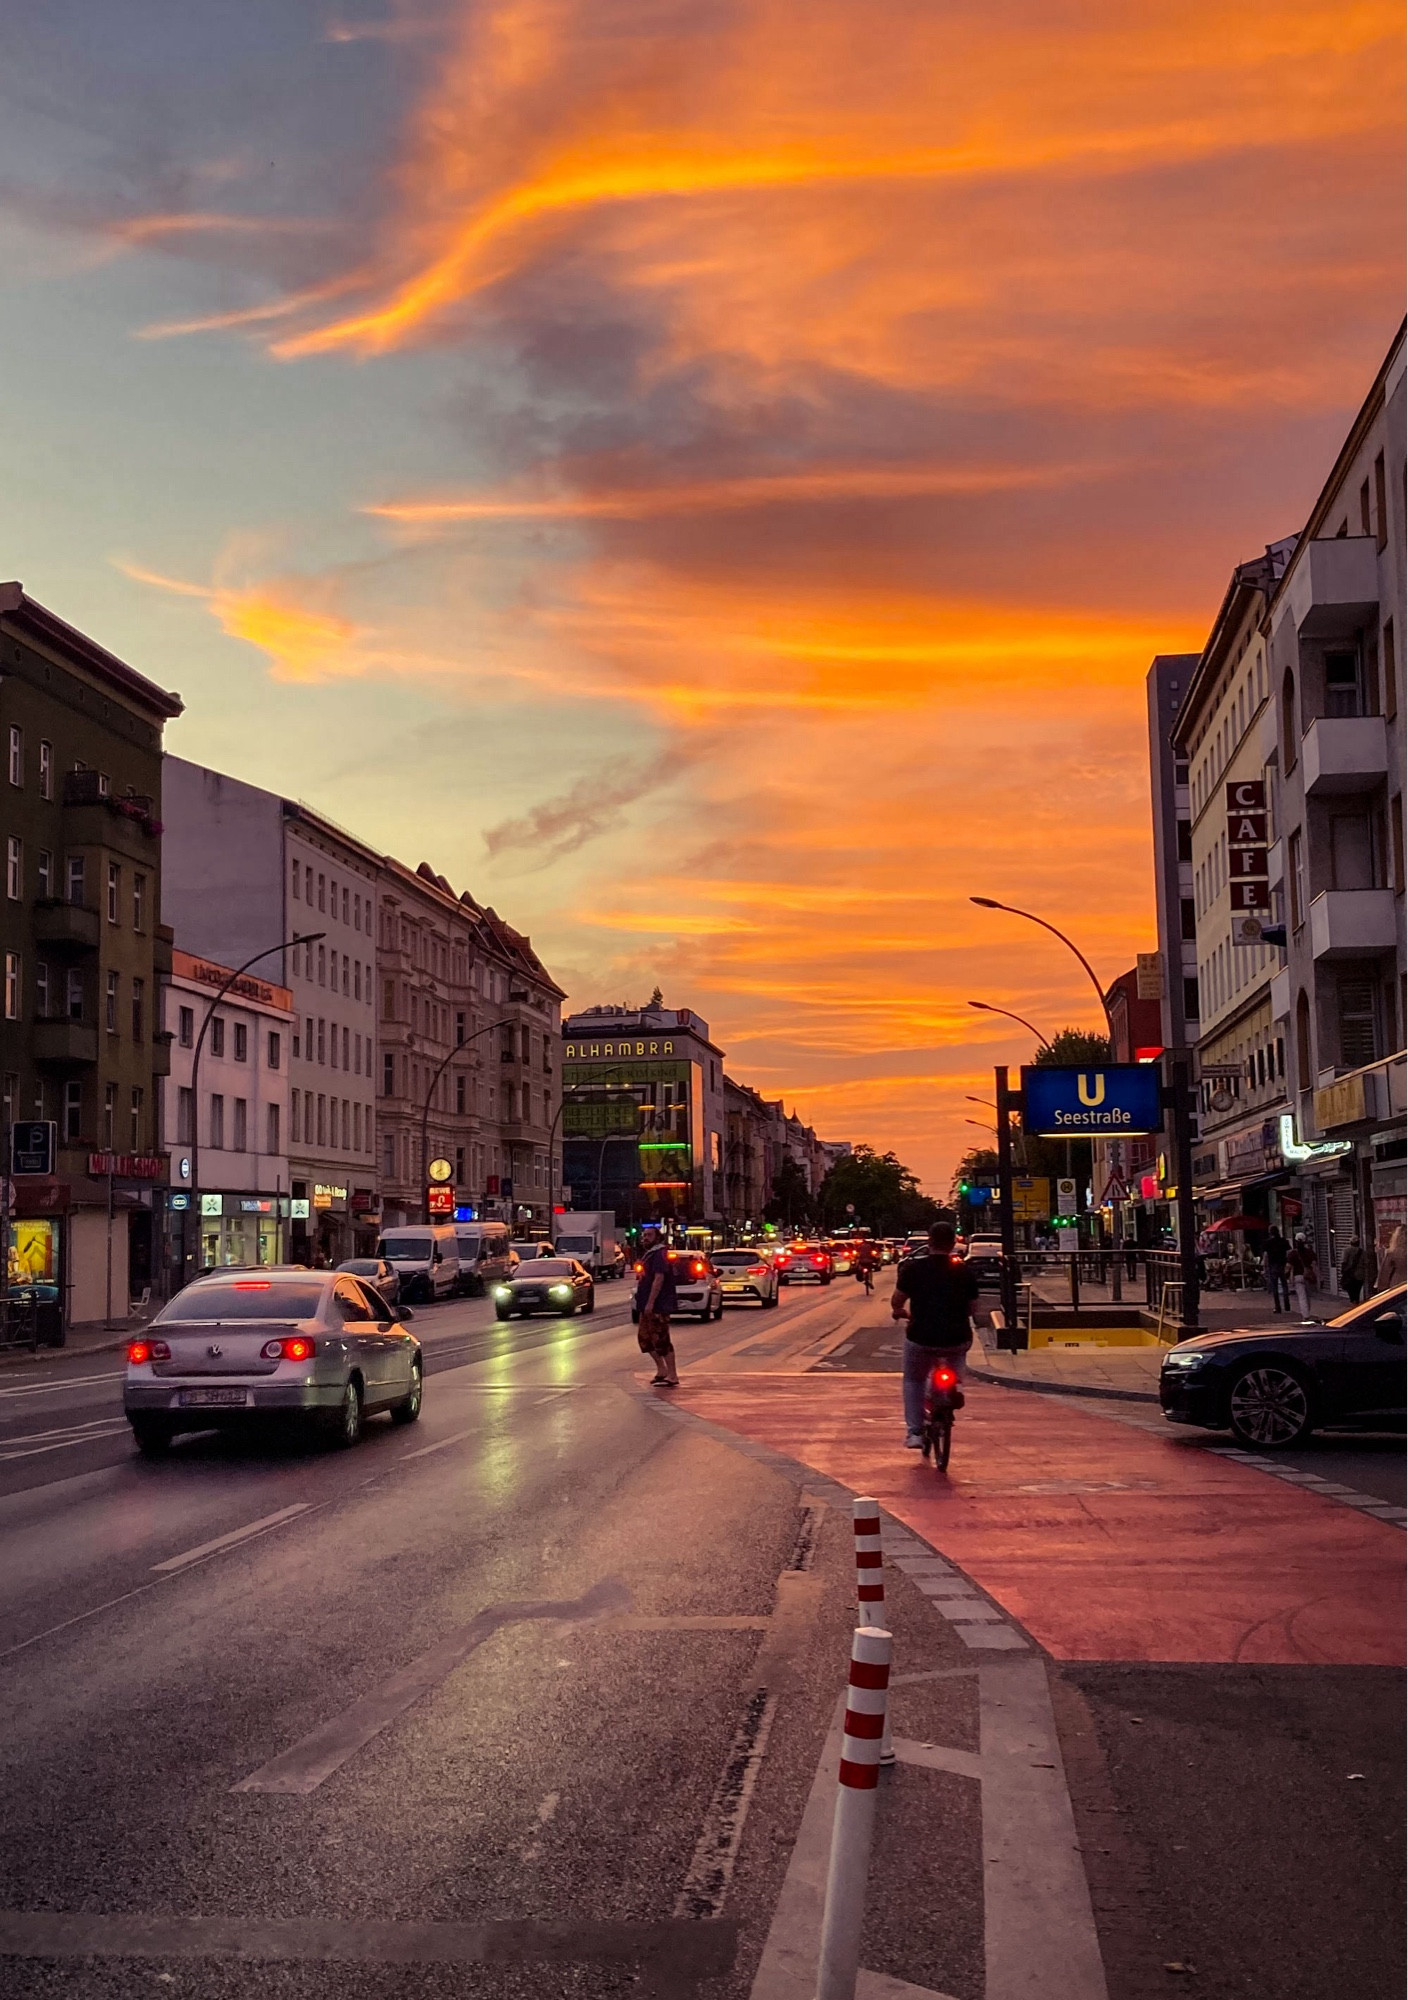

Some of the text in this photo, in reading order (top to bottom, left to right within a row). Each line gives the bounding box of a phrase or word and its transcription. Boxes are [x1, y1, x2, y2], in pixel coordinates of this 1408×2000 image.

[1235, 784, 1257, 906] CAFE
[566, 1041, 673, 1058] ALHAMBRA
[1078, 1074, 1105, 1106] U
[1054, 1107, 1131, 1125] Seestraße
[991, 1187, 1001, 1199] U
